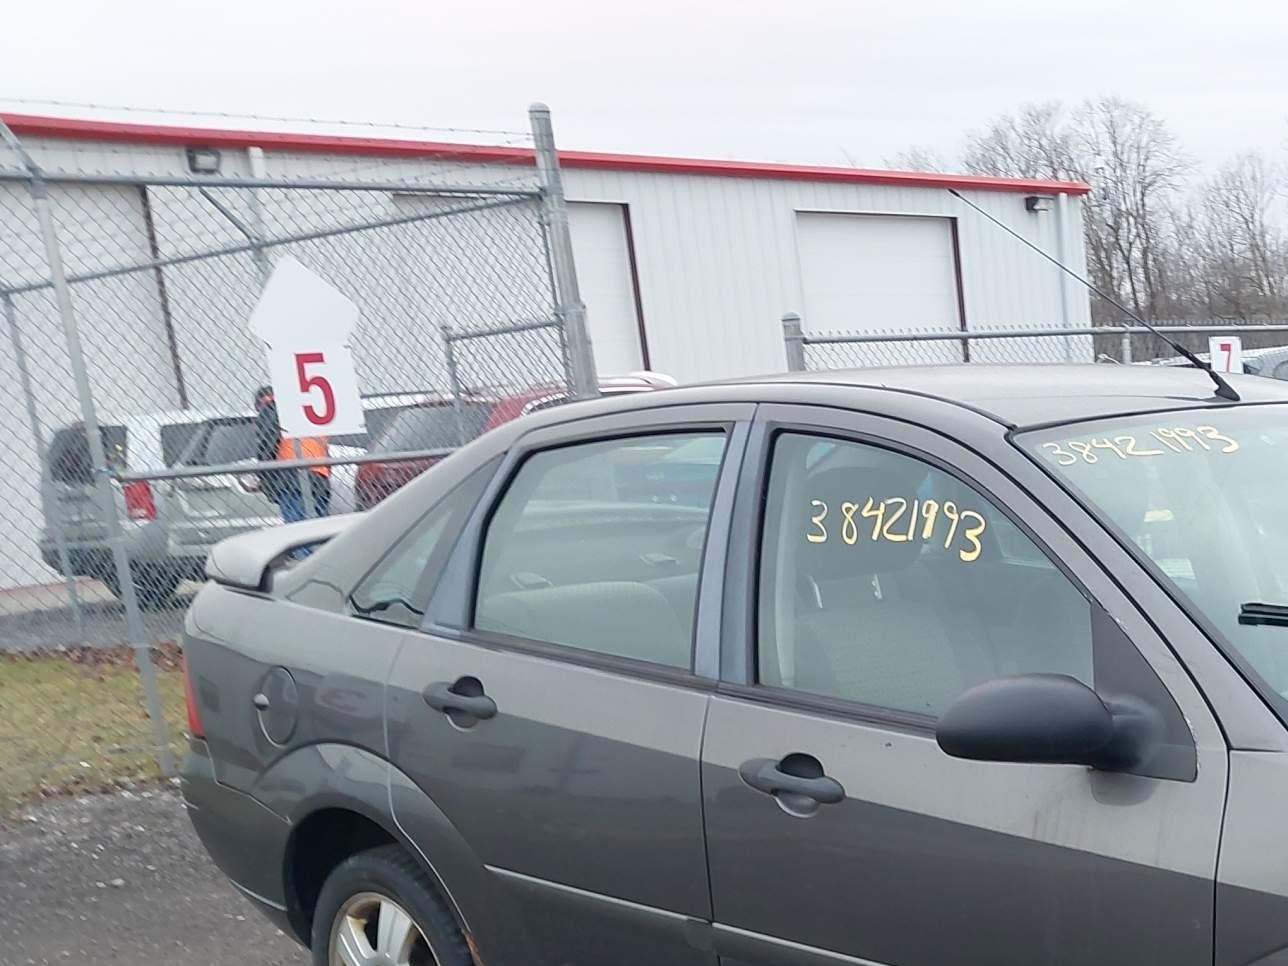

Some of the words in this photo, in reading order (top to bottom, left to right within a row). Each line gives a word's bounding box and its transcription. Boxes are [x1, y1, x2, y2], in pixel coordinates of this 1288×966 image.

[1219, 344, 1231, 373] 7
[295, 353, 335, 425] 5
[1042, 425, 1240, 466] 38421993
[806, 496, 986, 562] 38421993
